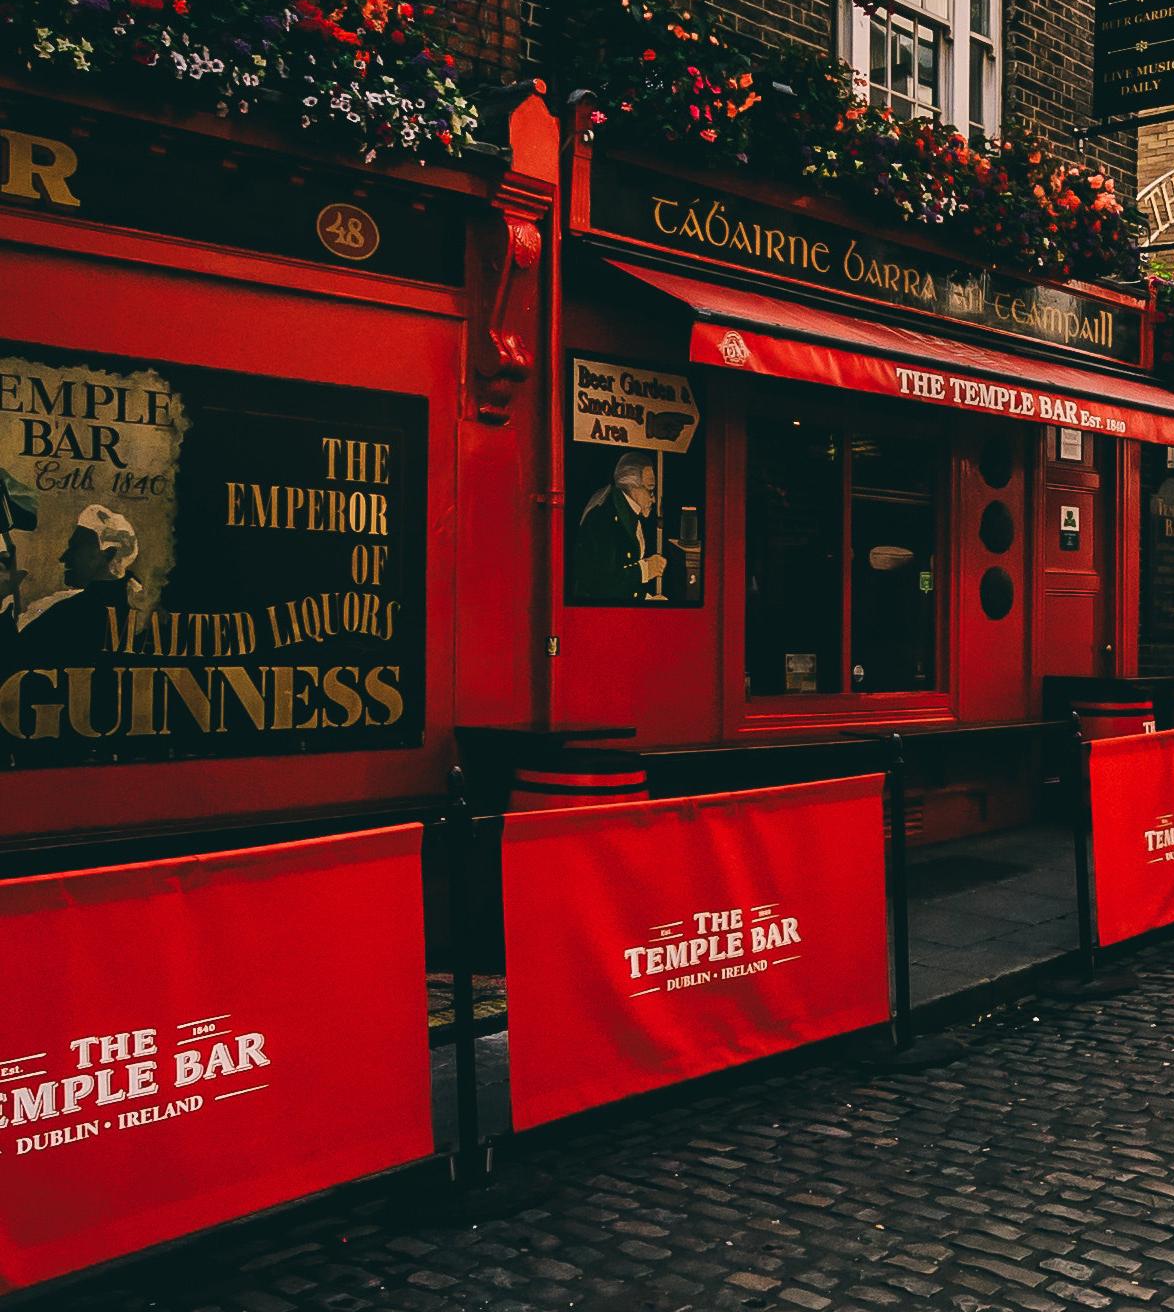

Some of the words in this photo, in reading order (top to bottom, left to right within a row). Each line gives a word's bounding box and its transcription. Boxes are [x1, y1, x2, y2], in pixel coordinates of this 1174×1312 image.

[1104, 66, 1132, 83] LIVE
[1121, 79, 1161, 96] DAILY
[325, 211, 364, 247] 48
[0, 373, 175, 427] EMPLE
[578, 365, 615, 393] Beer
[620, 372, 676, 401] Garden
[896, 368, 945, 399] THE
[949, 377, 1035, 416] TEMPLE
[1038, 394, 1079, 425] BAR
[1106, 418, 1126, 433] 1840
[578, 390, 644, 425] Smoking
[19, 418, 128, 469] BAR
[591, 418, 628, 443] Area
[322, 437, 390, 485] THE
[225, 482, 389, 535] EMPEROR
[351, 544, 388, 585] OF
[101, 606, 256, 657] MALTED
[266, 591, 401, 649] LIQUORS
[0, 665, 404, 739] GUINNESS
[693, 909, 743, 935] THE
[624, 931, 745, 979] TEMPLE
[751, 917, 801, 953] BAR
[666, 971, 711, 991] DUBLIN
[721, 959, 768, 980] IRELAND
[70, 1028, 157, 1069] THE
[192, 1023, 215, 1036] 1840
[0, 1060, 158, 1128] MPLE
[173, 1032, 271, 1088] BAR
[1, 1065, 24, 1076] Est.
[16, 1119, 100, 1155] DUBLIN
[118, 1095, 203, 1130] IRELAND
